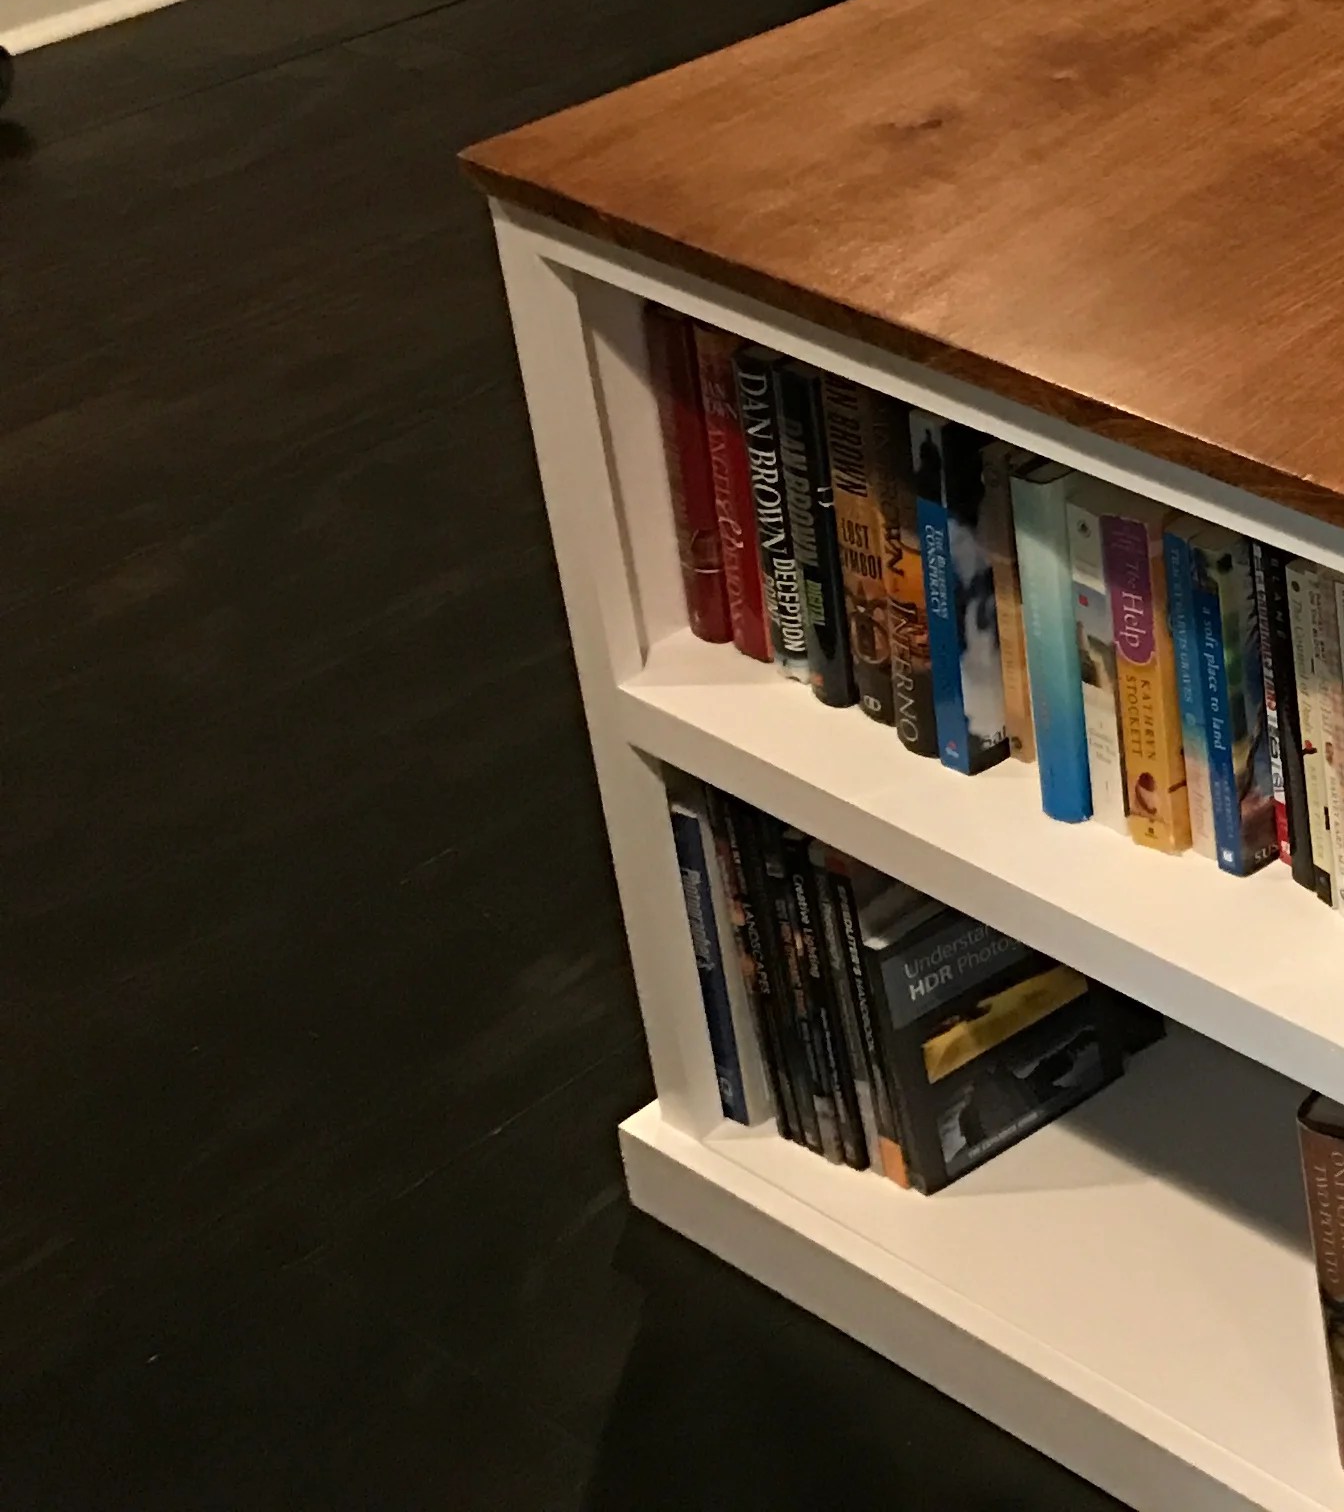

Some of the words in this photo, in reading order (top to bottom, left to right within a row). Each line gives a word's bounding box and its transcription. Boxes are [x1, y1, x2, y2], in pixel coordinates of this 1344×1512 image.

[737, 371, 774, 440] DAN
[828, 412, 869, 498] BROWN
[749, 446, 789, 555] BROWN
[785, 472, 820, 568] BROWN
[841, 517, 870, 549] LOST
[772, 557, 807, 652] DECEPTION
[804, 578, 826, 627] DIGITAL
[924, 524, 942, 614] CONSPIRACY
[1118, 590, 1150, 649] Help
[1202, 606, 1211, 616] a
[1202, 620, 1219, 649] soft
[888, 598, 919, 743] INFERNO
[1203, 651, 1221, 691] place
[1210, 695, 1220, 713] to
[1125, 674, 1144, 758] STOCKETT
[1140, 679, 1157, 761] KATHRYN
[1211, 716, 1227, 750] land
[742, 901, 771, 995] LANDSCAPES
[792, 873, 811, 926] Creative
[802, 926, 821, 980] Lighting
[855, 977, 875, 1051] HANDBOOK
[907, 965, 955, 1002] HDR
[1313, 1165, 1330, 1208] TWO
[1320, 1210, 1340, 1284] POTATO
